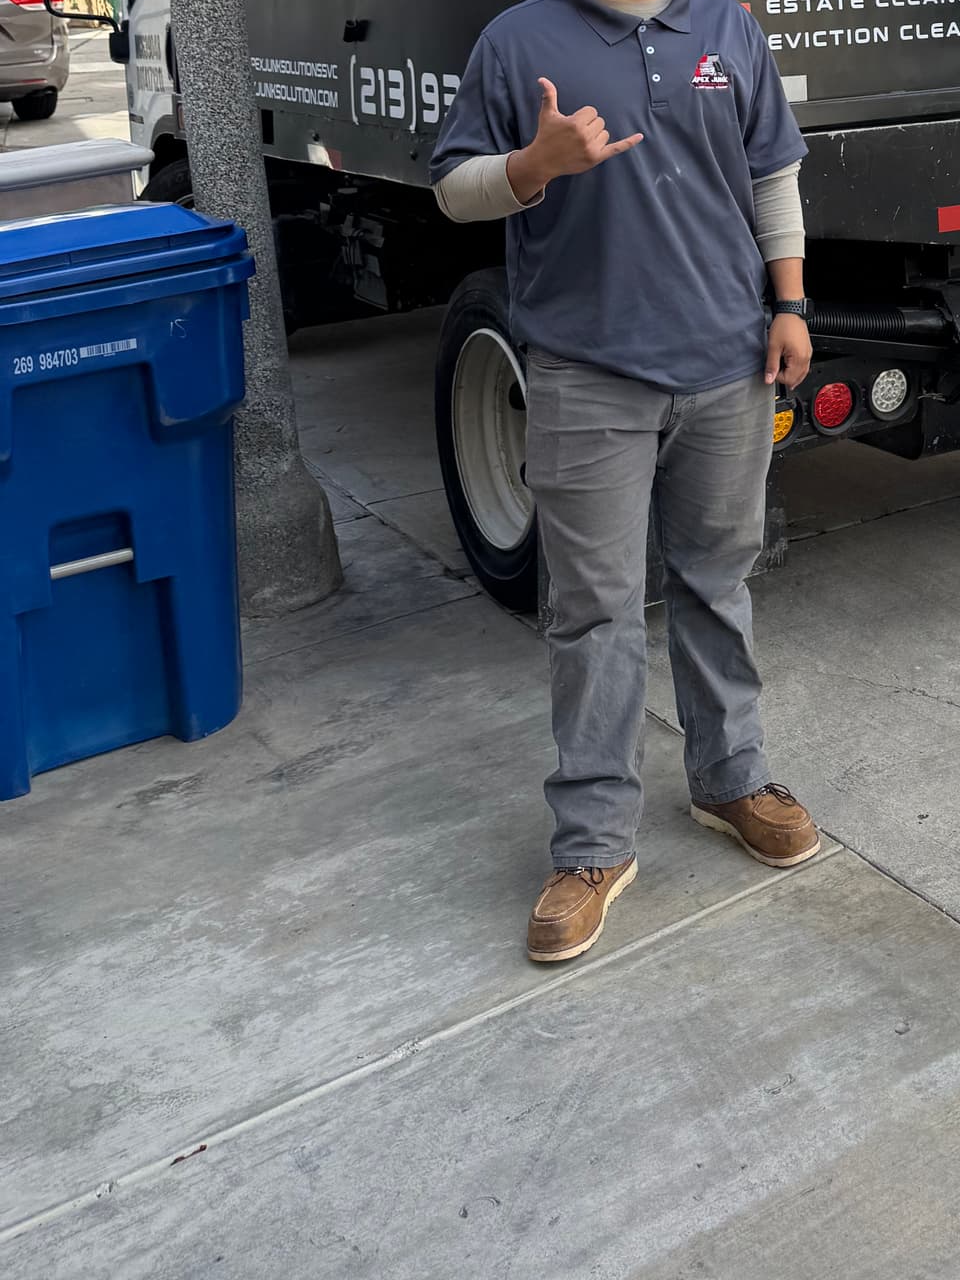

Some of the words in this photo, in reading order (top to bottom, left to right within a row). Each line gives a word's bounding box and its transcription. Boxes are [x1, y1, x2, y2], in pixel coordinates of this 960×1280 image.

[767, 26, 889, 51] EVICTION
[250, 57, 338, 80] PEXJUNKSOLUTIONSSVC
[254, 81, 338, 108] JUNKSOLUTION.COM
[351, 54, 461, 133] (213)93
[13, 356, 34, 375] 269
[40, 348, 79, 370] 984703
